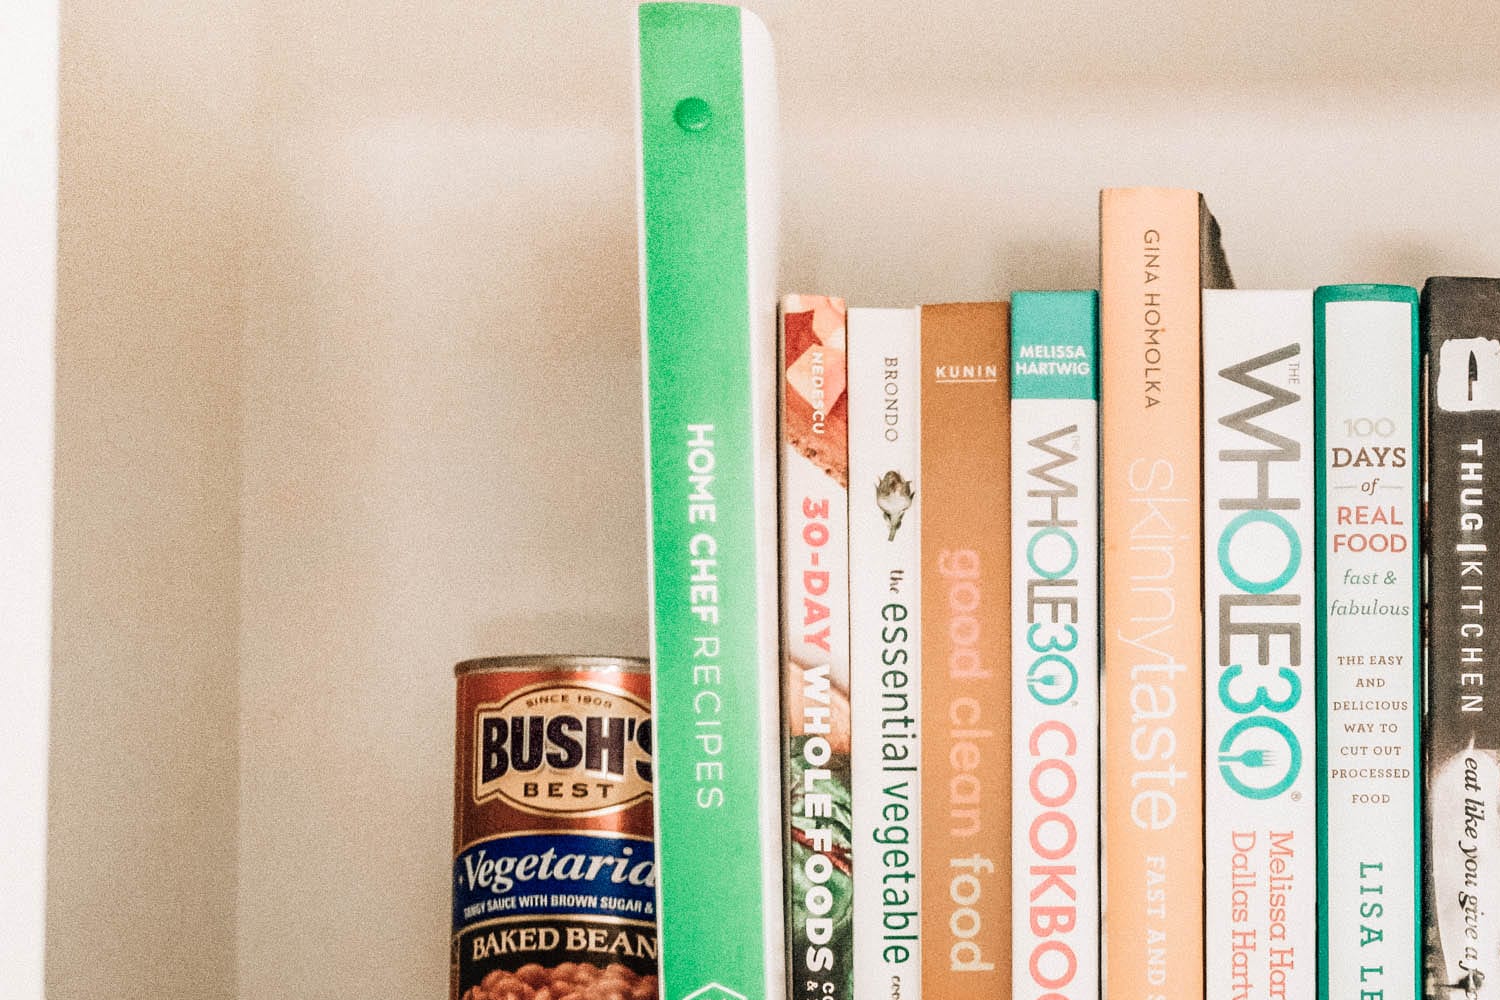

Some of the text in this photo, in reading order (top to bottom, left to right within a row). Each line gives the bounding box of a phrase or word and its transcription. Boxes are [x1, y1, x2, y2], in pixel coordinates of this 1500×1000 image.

[1143, 229, 1162, 410] GINA HOMOLKA
[1019, 345, 1086, 359] MELISSA
[935, 364, 997, 379] KUNIN
[1015, 361, 1090, 377] HARTWIG
[811, 351, 826, 435] NEDESCU
[883, 356, 899, 443] BRONDO
[1343, 418, 1396, 438] 100
[1332, 447, 1406, 468] DAYS
[1361, 478, 1380, 496] of
[1337, 506, 1403, 525] REAL
[1333, 533, 1407, 553] FOOD
[1026, 424, 1080, 706] WHOLE30
[1217, 342, 1302, 801] WHOLE30
[1344, 569, 1397, 585] fast &
[1460, 439, 1484, 713] THUG KITCHEN
[888, 569, 905, 594] the
[686, 424, 724, 810] HOME CHEF RECIPES
[1330, 599, 1409, 617] fabulous
[1118, 457, 1190, 831] skinnytaste
[1337, 656, 1403, 666] THE EASY
[1355, 678, 1385, 688] AND
[526, 694, 570, 708] SINCE
[1333, 701, 1408, 711] DELICIOUS
[802, 498, 834, 974] 30-DAY WHOLE FOODS
[1344, 723, 1398, 733] WAY TO
[938, 547, 995, 973] good clean food
[1340, 746, 1402, 756] CUT OUT
[873, 602, 918, 965] essential vegetable
[1331, 768, 1410, 779] PROCESSED
[1464, 757, 1483, 792] eat
[523, 782, 614, 799] BEST
[1352, 794, 1390, 804] FOOD
[1464, 798, 1485, 839] like
[464, 847, 657, 894] Vegetaria
[1458, 840, 1479, 887] you
[1145, 856, 1166, 920] FAST
[1231, 831, 1256, 925] Dallas
[1269, 831, 1295, 940] Melissa
[487, 896, 517, 913] SAUCE
[518, 894, 548, 909] WITH
[551, 894, 597, 909] BROWN
[600, 896, 642, 913] SUGAR
[644, 902, 653, 914] &
[1360, 861, 1384, 947] LISA
[1458, 890, 1485, 940] give
[472, 928, 658, 961] BAKED BEAN
[1147, 928, 1167, 985] AND
[1465, 946, 1479, 961] a
[806, 980, 819, 991] &
